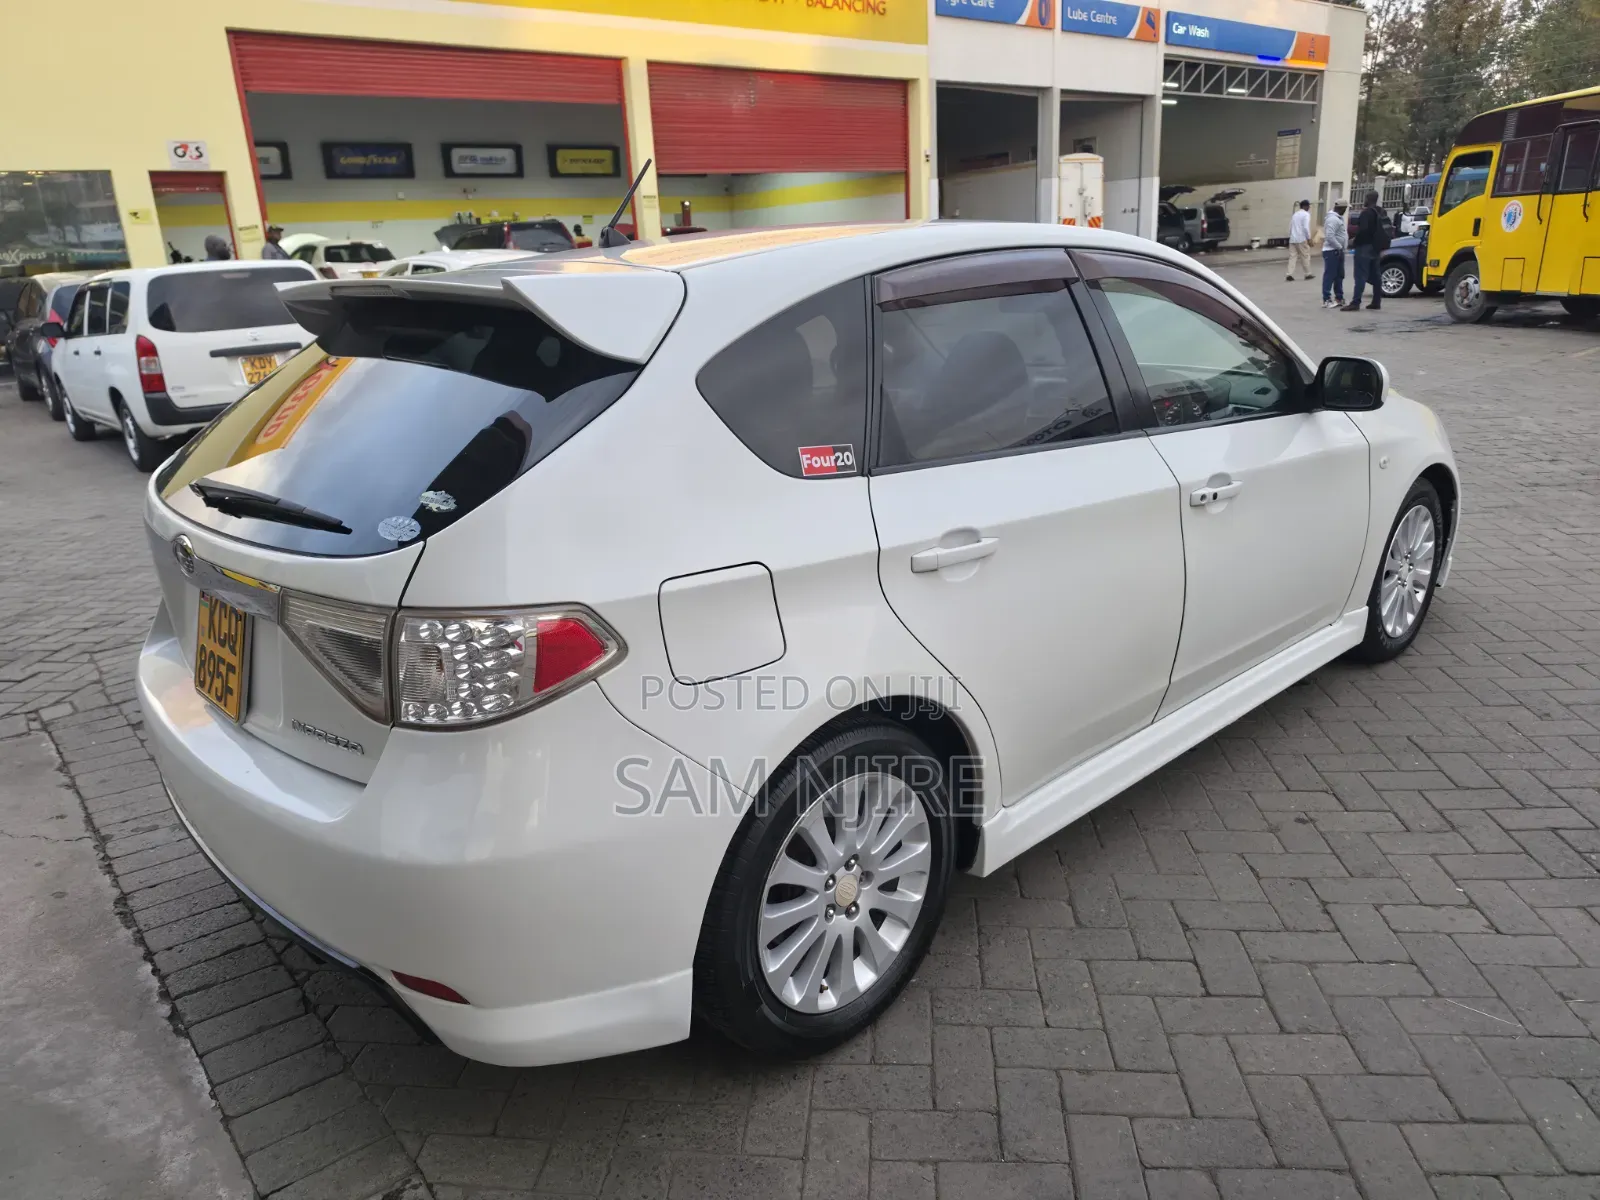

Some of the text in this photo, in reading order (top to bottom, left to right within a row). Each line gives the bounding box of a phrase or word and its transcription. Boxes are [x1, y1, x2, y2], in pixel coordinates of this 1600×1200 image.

[1067, 7, 1118, 26] Lube Centre
[1172, 22, 1210, 38] Car Wash
[801, 451, 853, 469] Four20
[207, 596, 238, 657] KCQ
[198, 644, 236, 708] 895F
